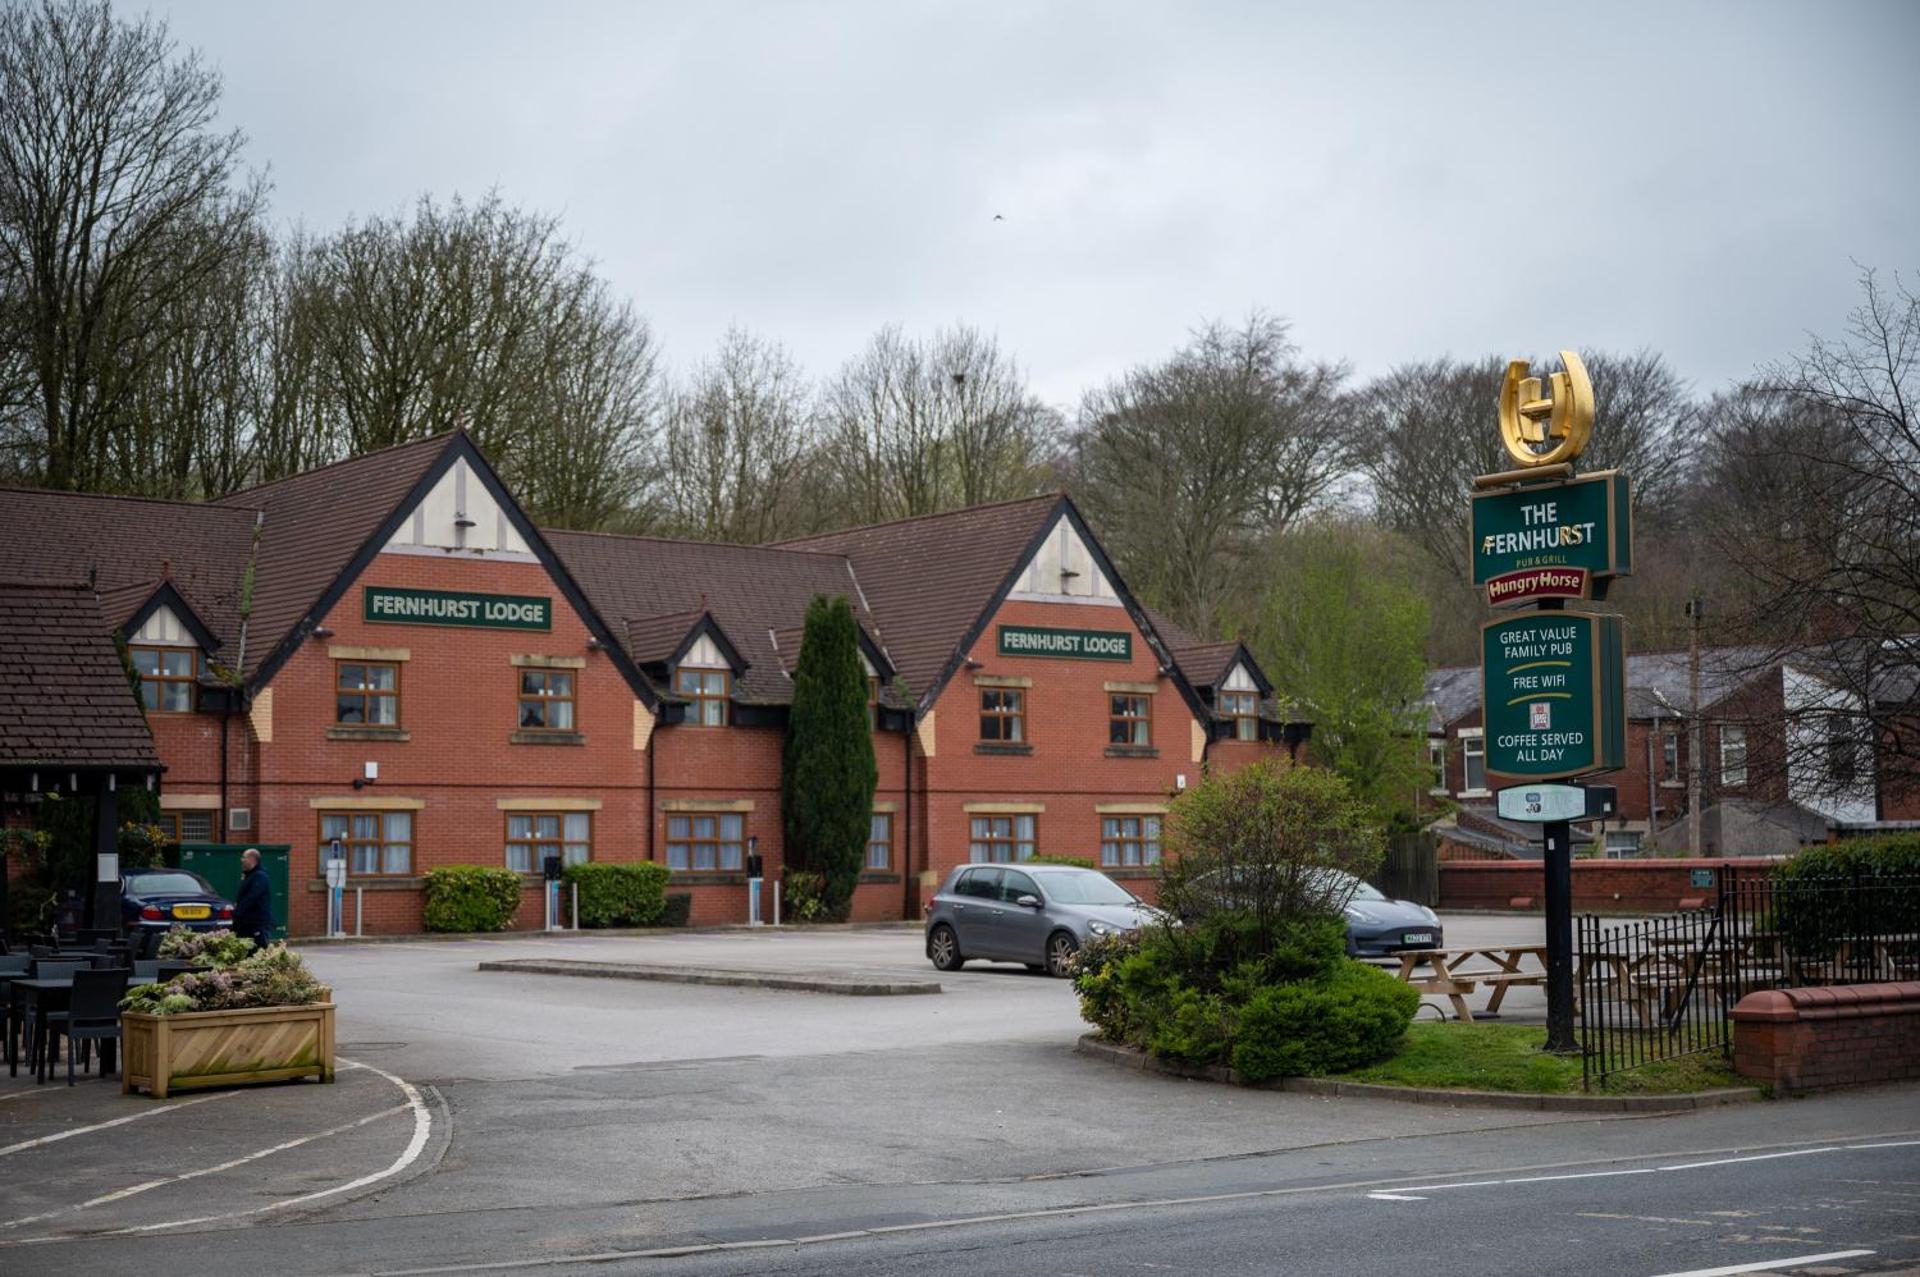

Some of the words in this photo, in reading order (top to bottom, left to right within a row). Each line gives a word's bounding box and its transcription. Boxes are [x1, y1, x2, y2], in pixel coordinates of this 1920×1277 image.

[1520, 502, 1557, 526] THE
[1482, 522, 1595, 556] FERNHURST
[1516, 557, 1533, 568] PUB
[1542, 554, 1567, 564] GRILL
[373, 595, 480, 618] FERNHURST
[485, 602, 544, 622] LODGE
[1004, 632, 1080, 651] FERNHURST
[1084, 637, 1126, 654] LODGE
[1500, 629, 1536, 644] GREAT
[1540, 626, 1577, 641] VALUE
[1504, 644, 1547, 659] FAMILY
[1550, 642, 1573, 655] PUB
[1513, 676, 1538, 689] FREE
[1541, 674, 1565, 687] WIFI
[1497, 733, 1538, 747] COFFEE
[1541, 732, 1584, 746] SERVED
[1516, 749, 1537, 762] ALL
[1541, 748, 1565, 761] DAY
